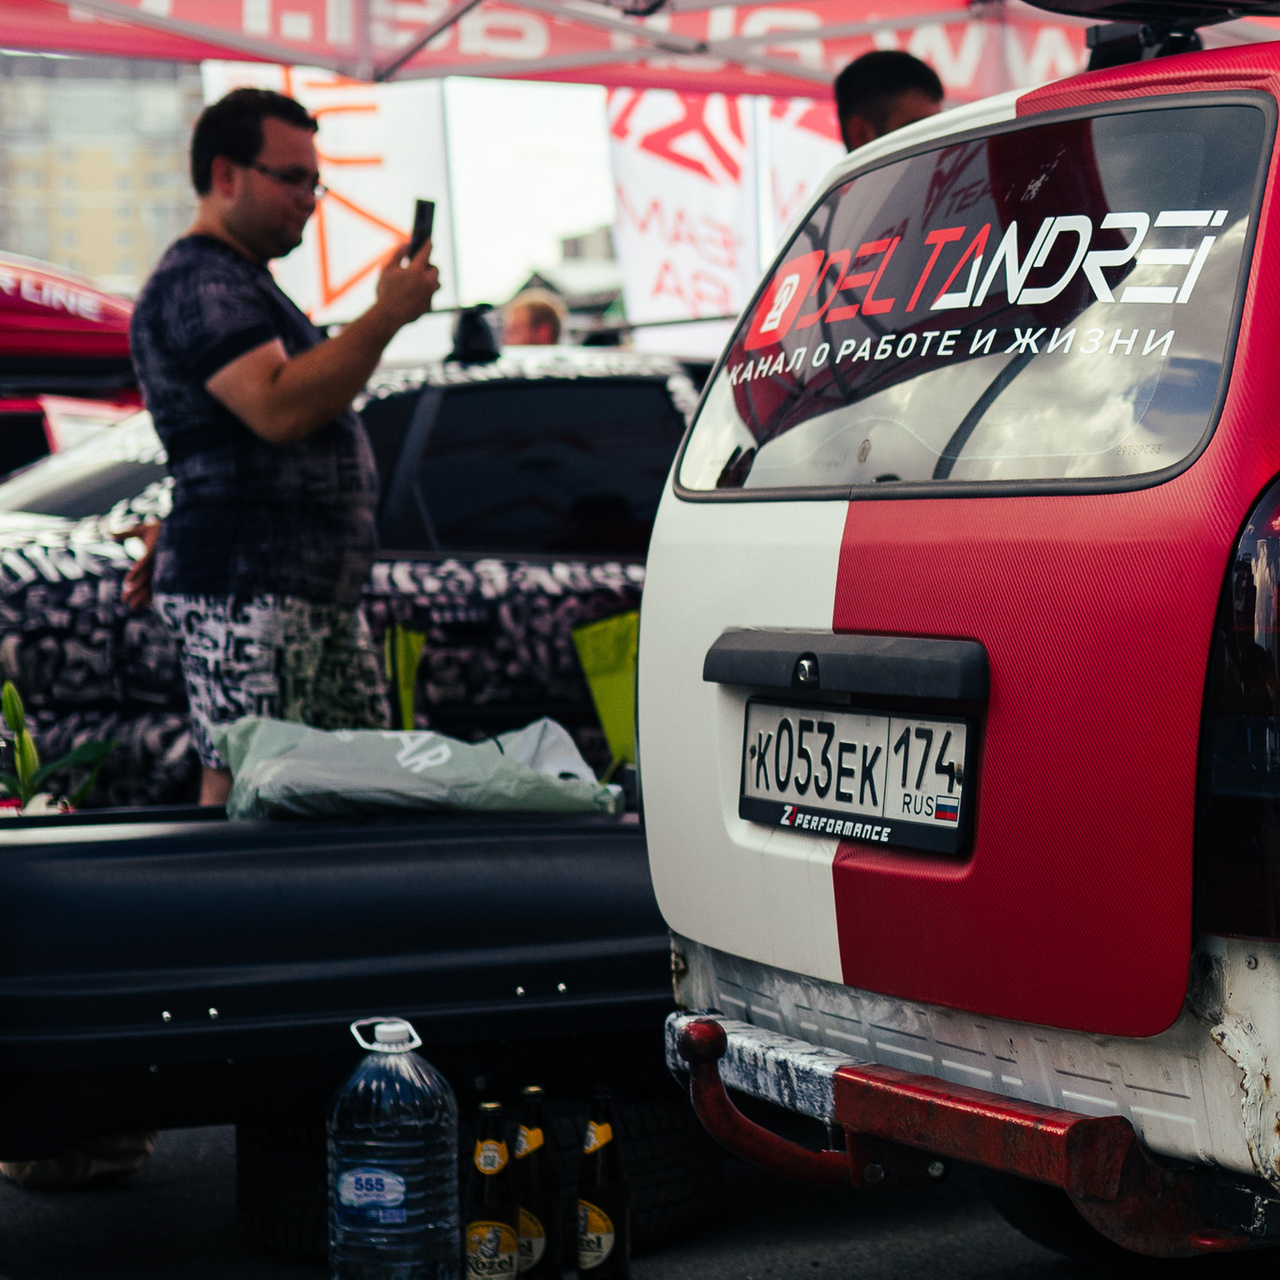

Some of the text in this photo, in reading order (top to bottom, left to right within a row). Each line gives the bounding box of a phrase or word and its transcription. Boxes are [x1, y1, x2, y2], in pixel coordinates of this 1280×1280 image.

[730, 327, 1177, 386] КАНАЛ О РАБОТЕ И ЖИЗНИ
[893, 726, 955, 794] 174
[902, 793, 934, 817] RUS
[795, 813, 892, 842] PERFORMANCE
[354, 1177, 385, 1192] 555
